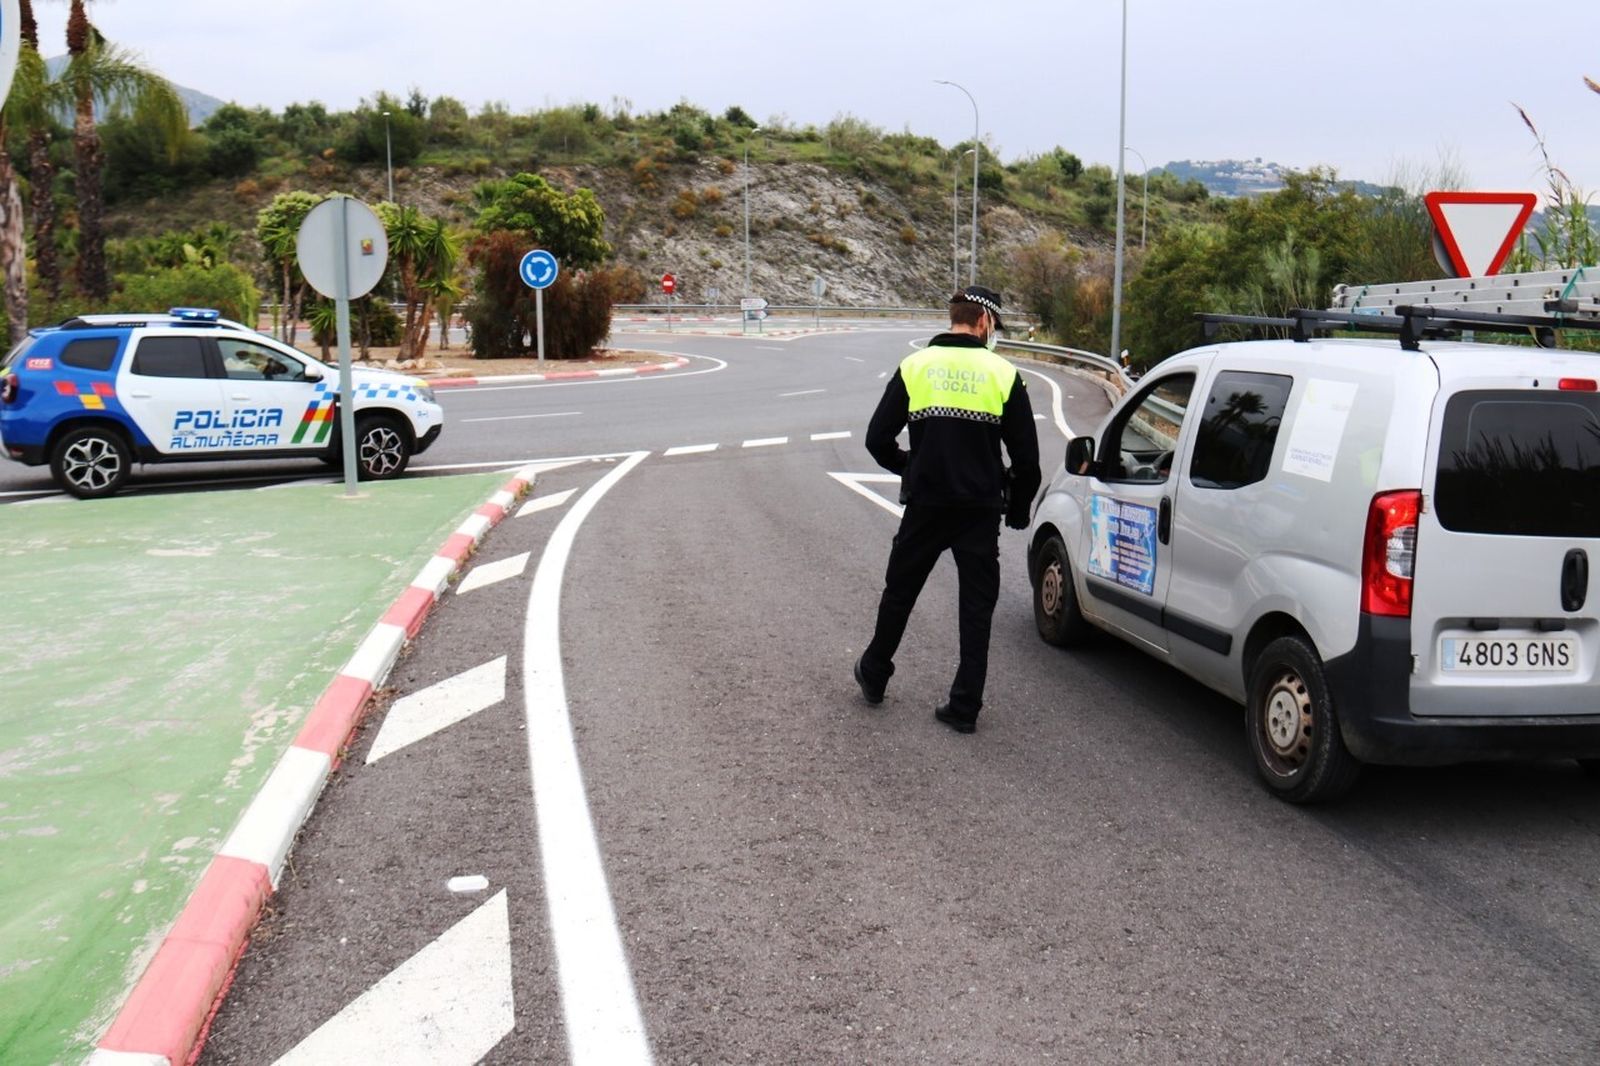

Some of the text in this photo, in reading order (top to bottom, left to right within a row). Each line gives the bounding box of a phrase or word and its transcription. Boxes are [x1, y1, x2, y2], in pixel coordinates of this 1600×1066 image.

[927, 368, 986, 383] POLICIA
[934, 381, 978, 394] LOCAL
[170, 431, 279, 449] ALMUÑÉCAR
[1459, 642, 1569, 666] 4803 GNS
